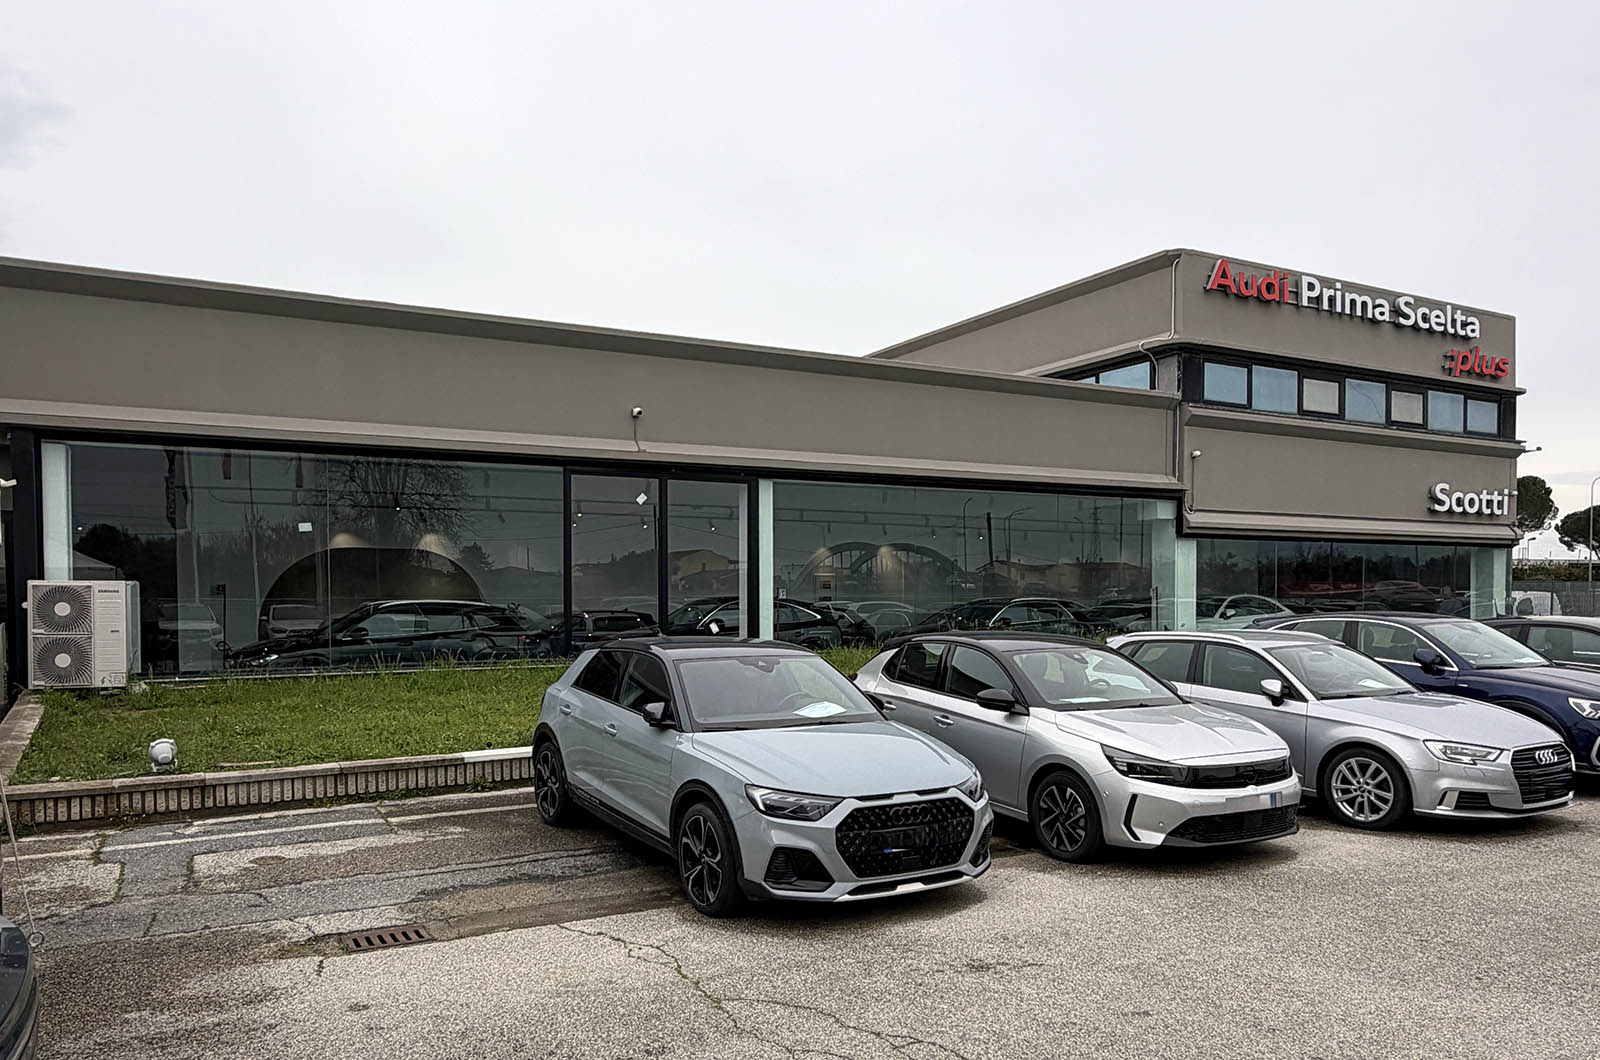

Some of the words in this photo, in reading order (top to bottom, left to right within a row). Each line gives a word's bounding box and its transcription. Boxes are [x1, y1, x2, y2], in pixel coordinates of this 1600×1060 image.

[1206, 258, 1289, 303] Audi
[1301, 275, 1390, 322] Prima
[1396, 295, 1480, 338] Scelta
[1434, 482, 1509, 515] Scotti
